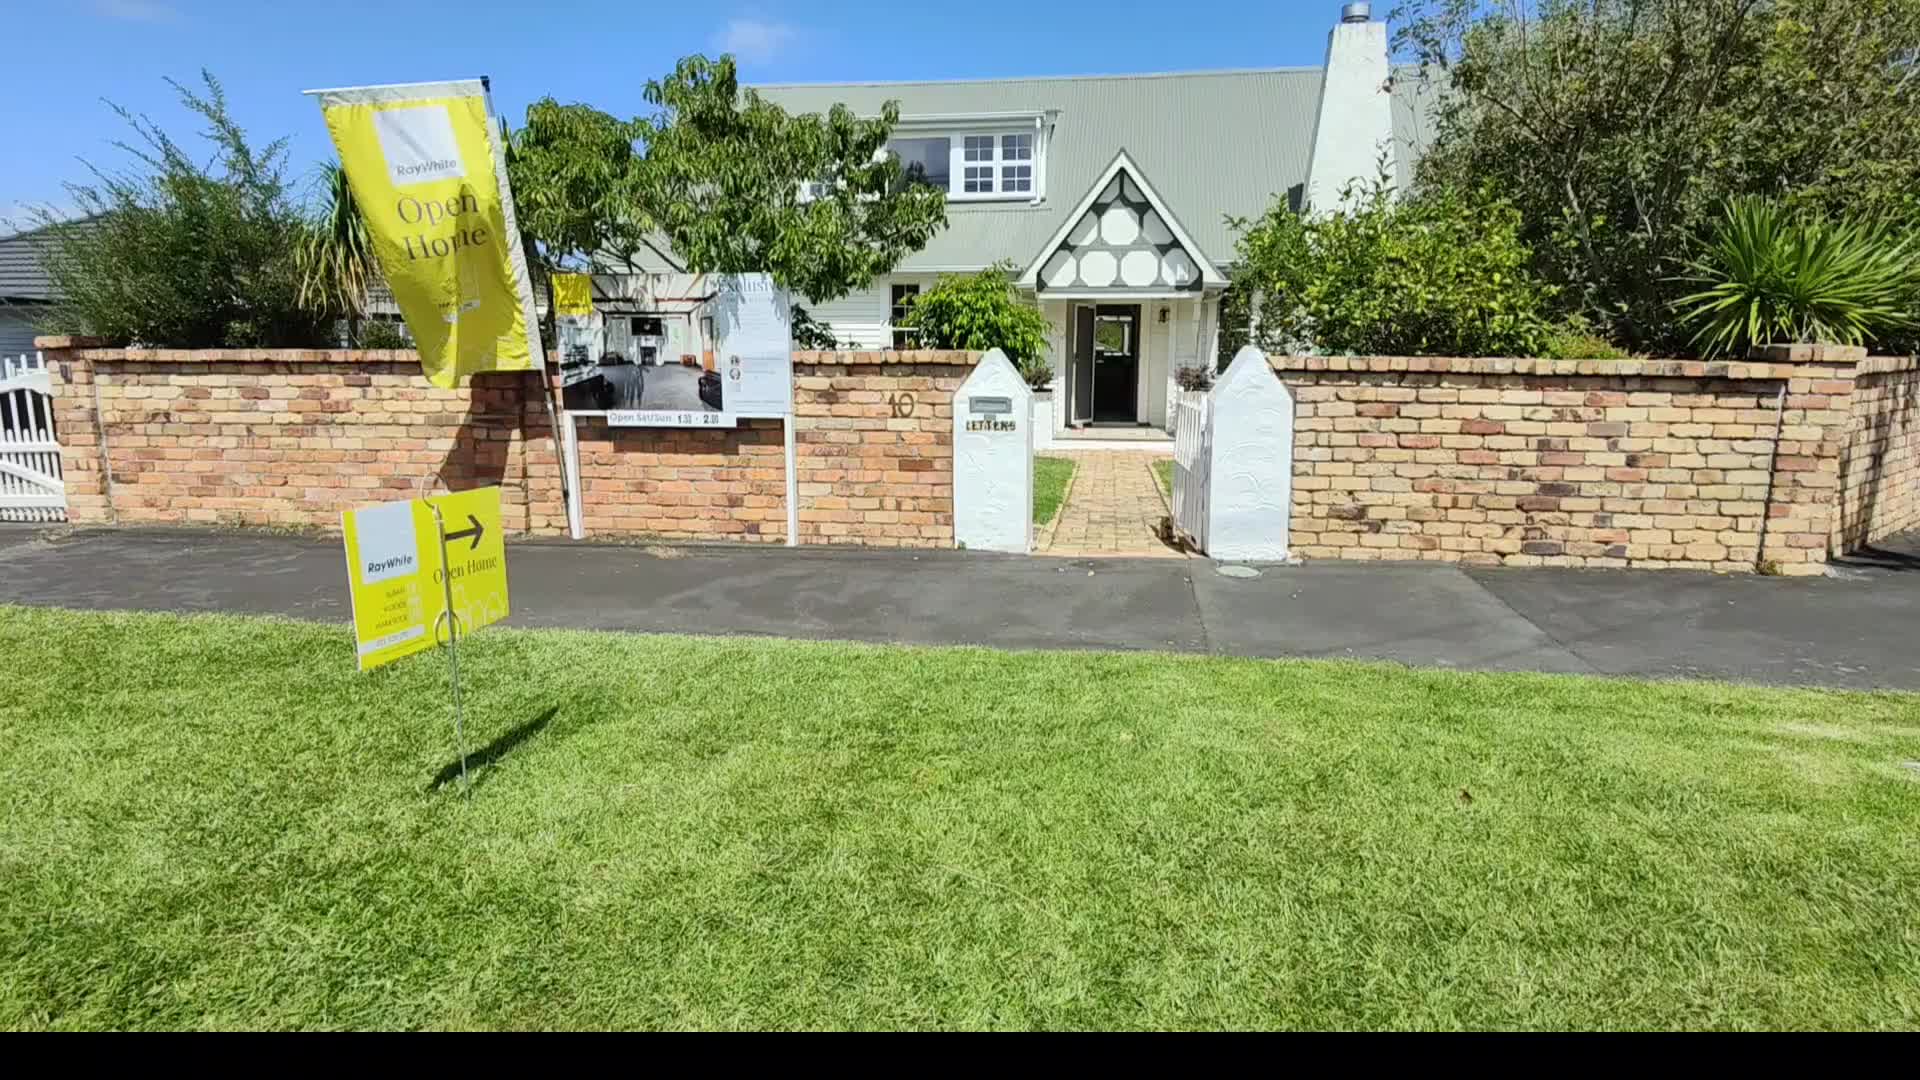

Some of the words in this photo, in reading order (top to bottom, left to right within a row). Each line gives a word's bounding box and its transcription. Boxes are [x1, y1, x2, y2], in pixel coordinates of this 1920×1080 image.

[397, 194, 479, 225] Open
[404, 227, 488, 260] Home
[888, 393, 914, 418] 10
[609, 412, 635, 423] Open
[966, 420, 1016, 431] LETTERS
[466, 556, 497, 576] Home
